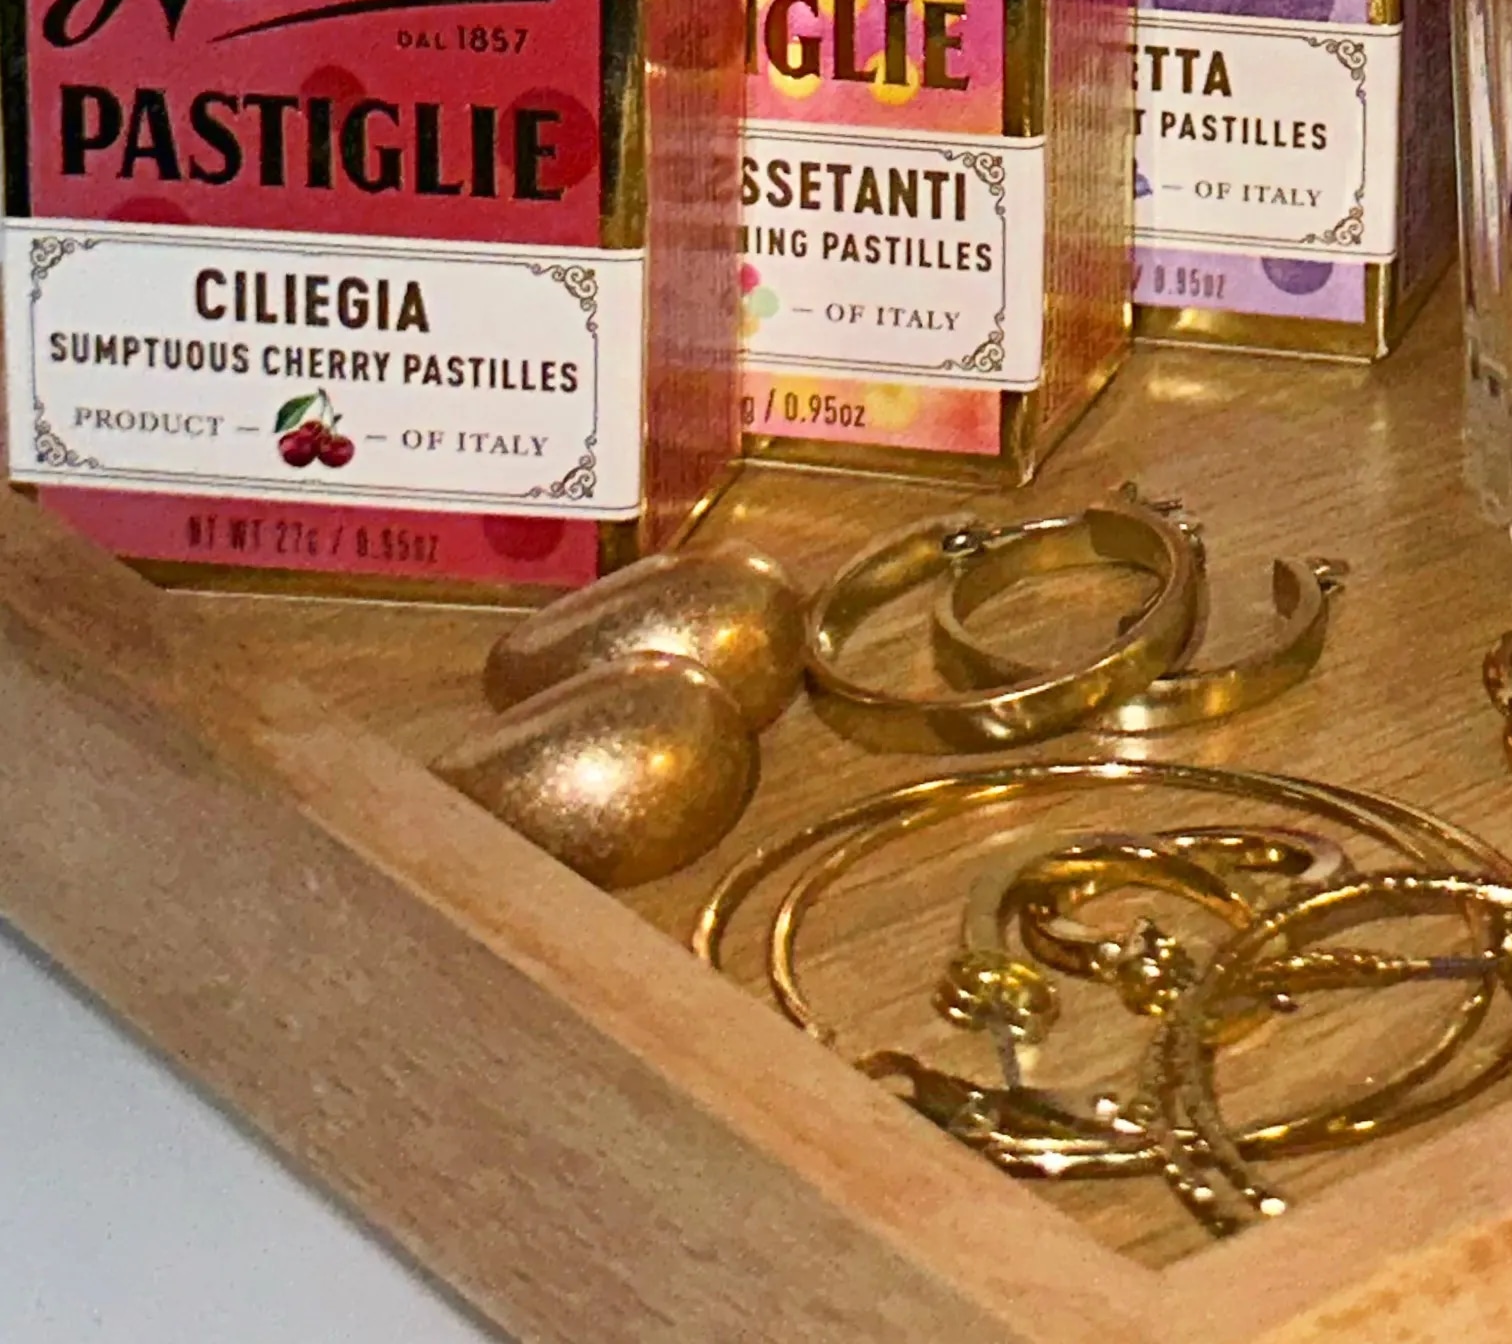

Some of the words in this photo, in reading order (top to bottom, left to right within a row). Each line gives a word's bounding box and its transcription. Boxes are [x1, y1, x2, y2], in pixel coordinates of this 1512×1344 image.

[396, 29, 447, 51] DAL
[456, 23, 529, 55] 1857
[59, 84, 564, 201] PASTIGLIE
[1161, 111, 1328, 151] PASTILLES
[1195, 180, 1231, 200] OF
[1243, 184, 1325, 208] ITALY
[822, 231, 993, 273] PASTILLES
[194, 268, 430, 334] CILIEGIA
[825, 303, 865, 324] OF
[876, 305, 961, 332] ITALY
[49, 332, 250, 375] SUMPTUOUS
[262, 345, 390, 383] CHERRY
[403, 354, 579, 393] PASTILLES
[784, 391, 866, 428] 0.95oz
[73, 407, 225, 437] PRODUCT
[401, 428, 444, 451] OF
[457, 431, 549, 458] ITALY
